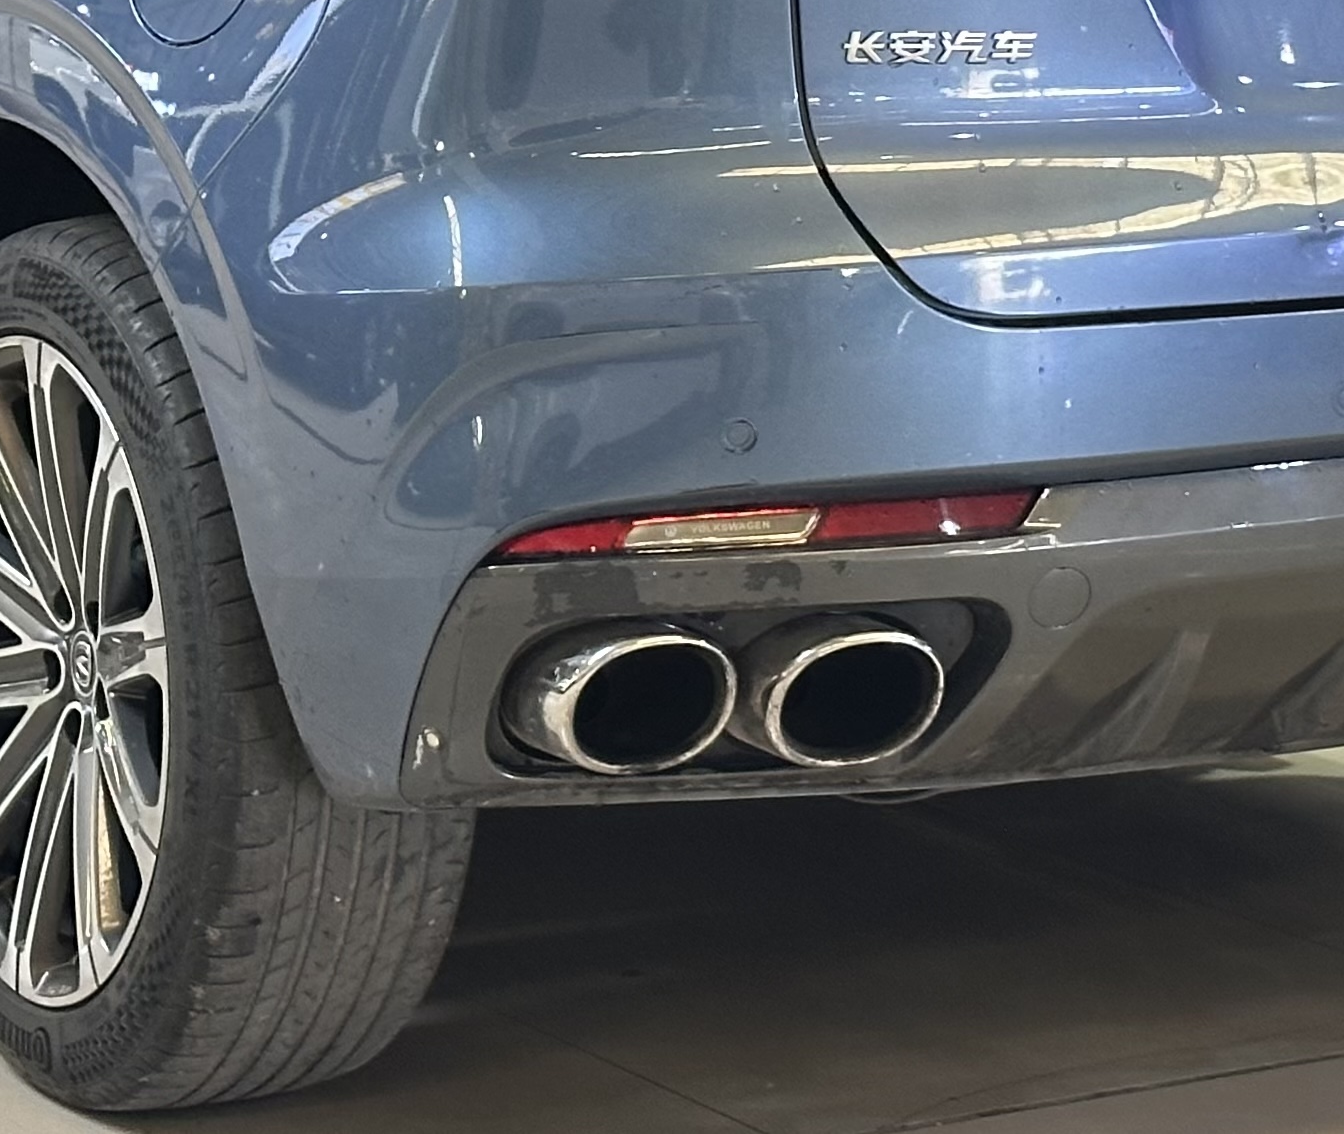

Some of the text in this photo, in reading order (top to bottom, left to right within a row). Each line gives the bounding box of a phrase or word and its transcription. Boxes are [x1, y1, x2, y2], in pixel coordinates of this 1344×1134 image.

[843, 30, 1038, 65] 长安汽车
[691, 520, 771, 535] VOLKSWAGEN
